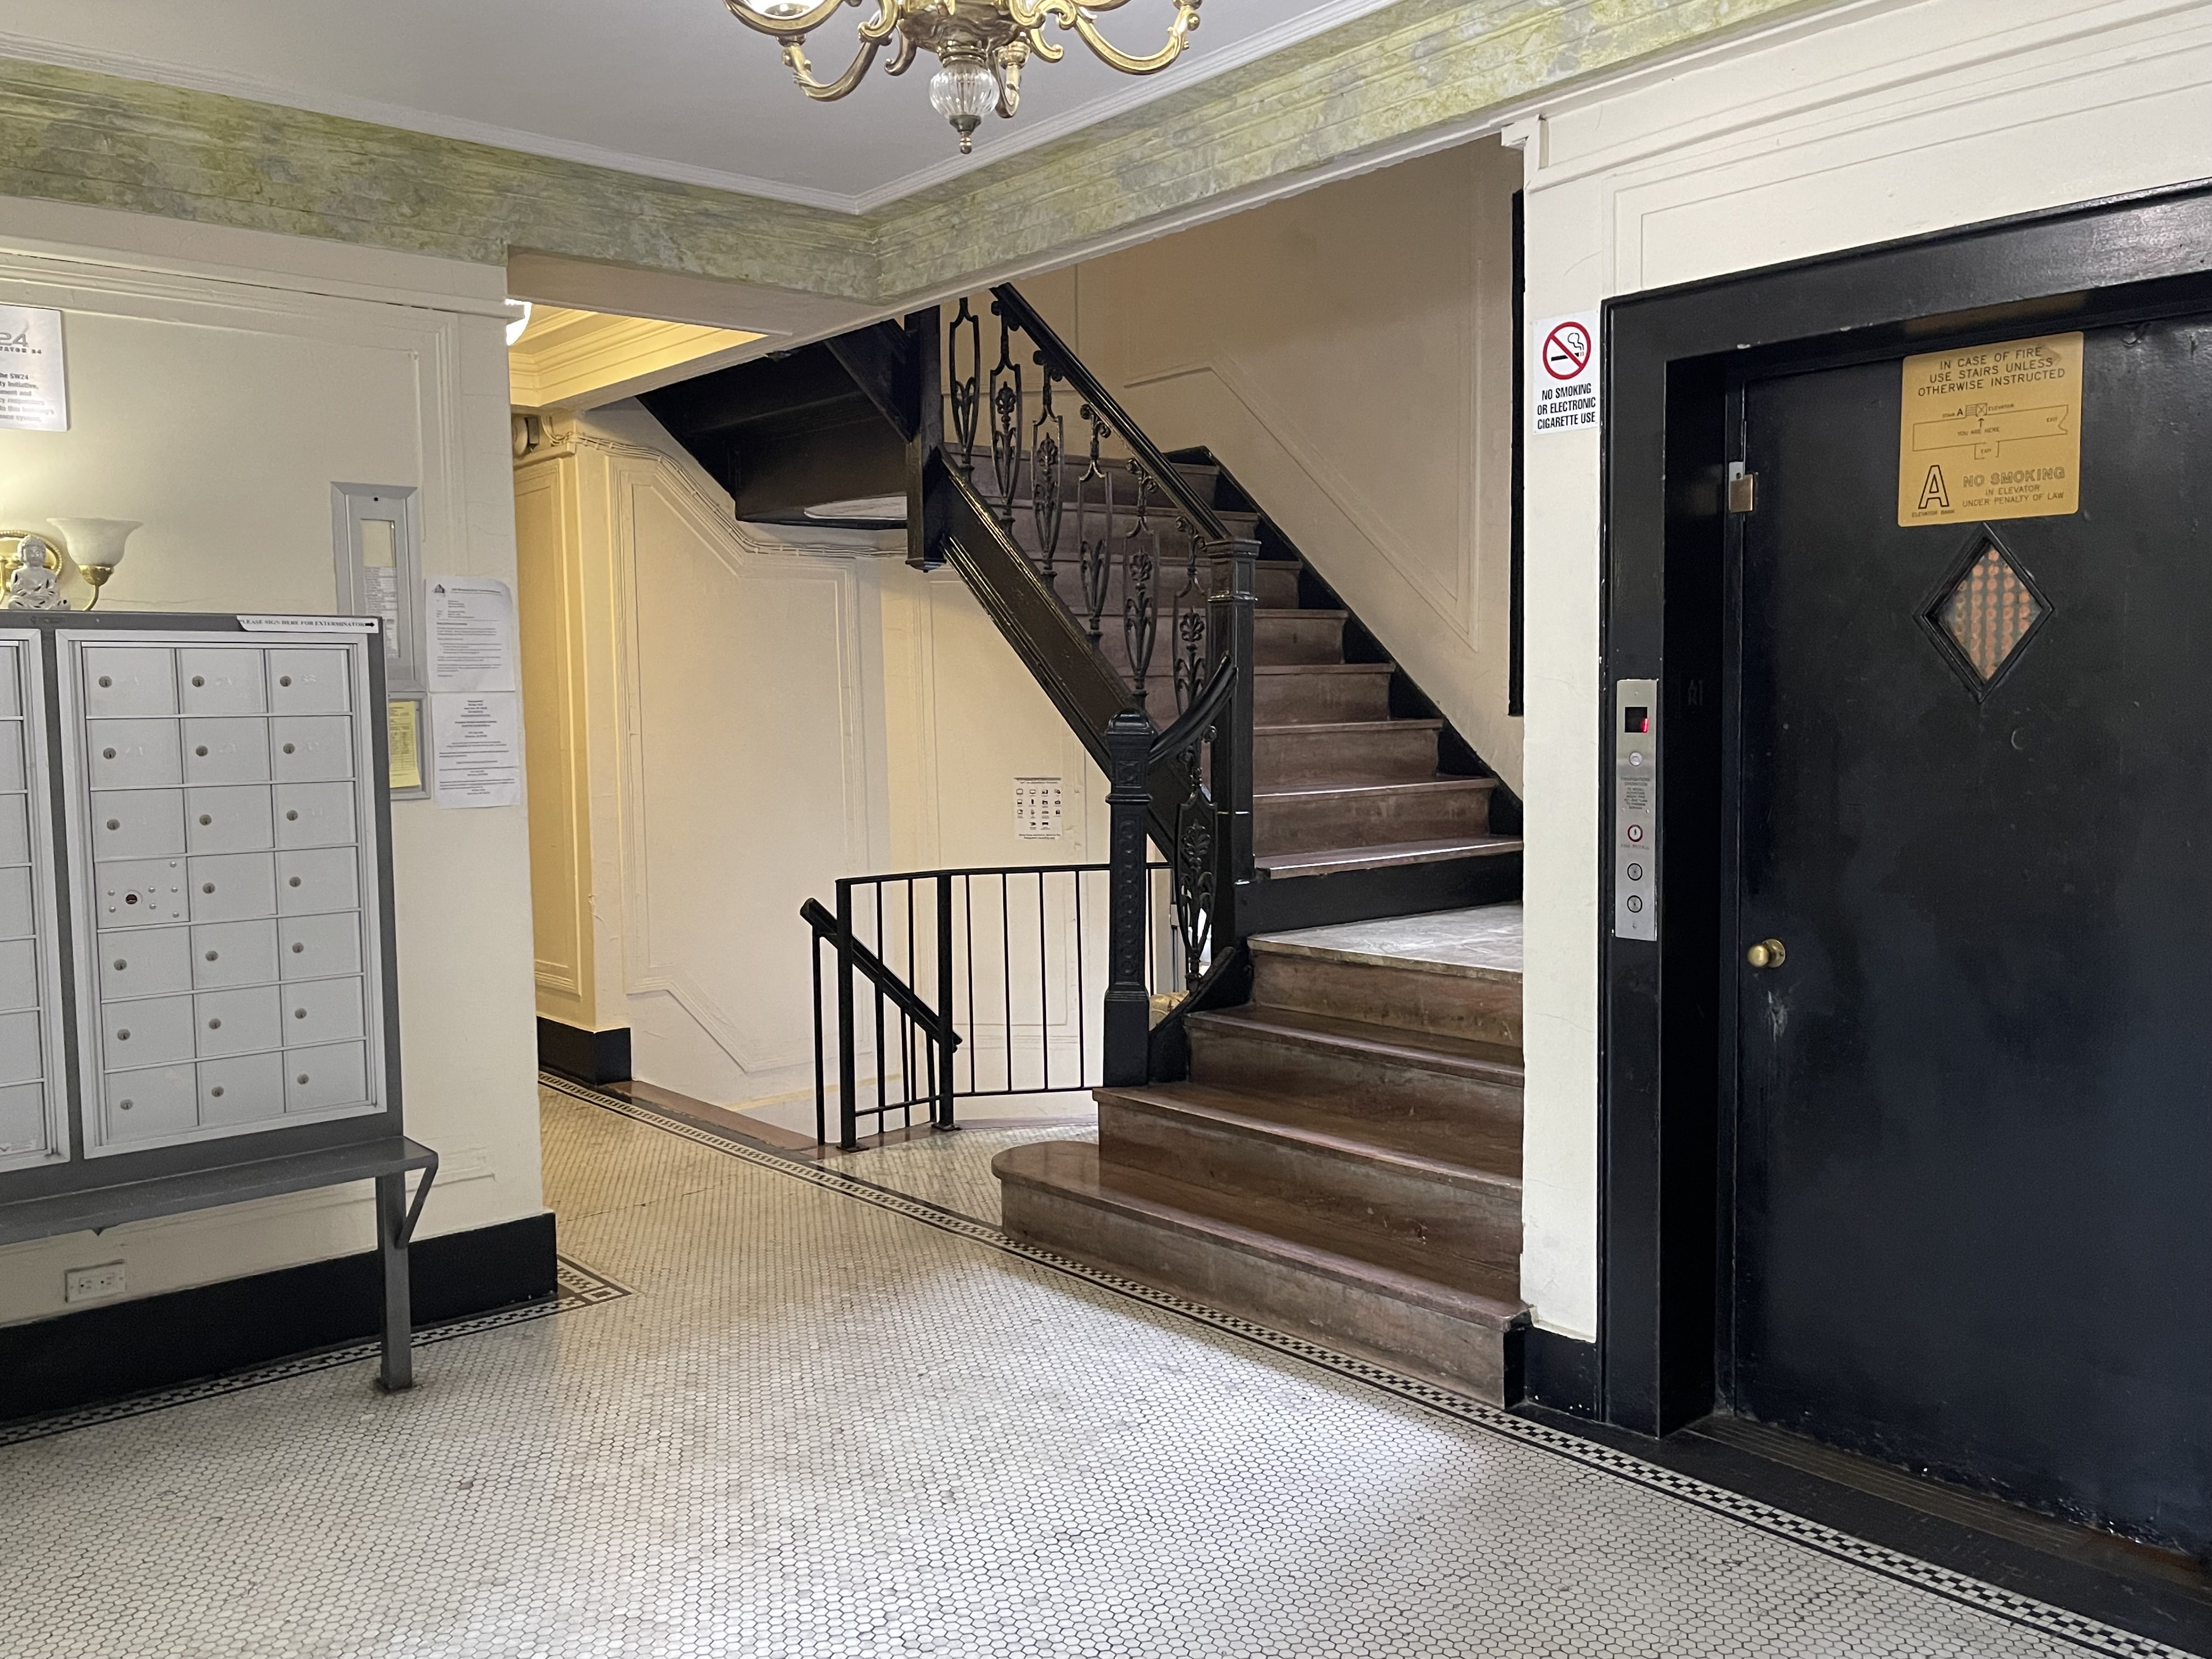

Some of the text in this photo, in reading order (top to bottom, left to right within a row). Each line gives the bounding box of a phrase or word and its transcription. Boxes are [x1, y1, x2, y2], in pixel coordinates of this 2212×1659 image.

[1940, 347, 2042, 370] IN CASE OF FIRE
[1929, 358, 2053, 383] USE STAIRS UNLESS
[1542, 383, 1591, 401] NO SMOKING
[1918, 368, 2065, 397] OTHERWISE INSTRUCTED
[1537, 397, 1596, 415] OR ELECTRONIC
[1956, 408, 1963, 416] A
[1537, 411, 1595, 430] CIGARETTE USE
[1963, 466, 2065, 488] NO SMOKING
[1918, 465, 1949, 509] A
[1998, 484, 2040, 495] ELEVATOR
[1962, 492, 2064, 507] UNDER PENALTY OF LAW
